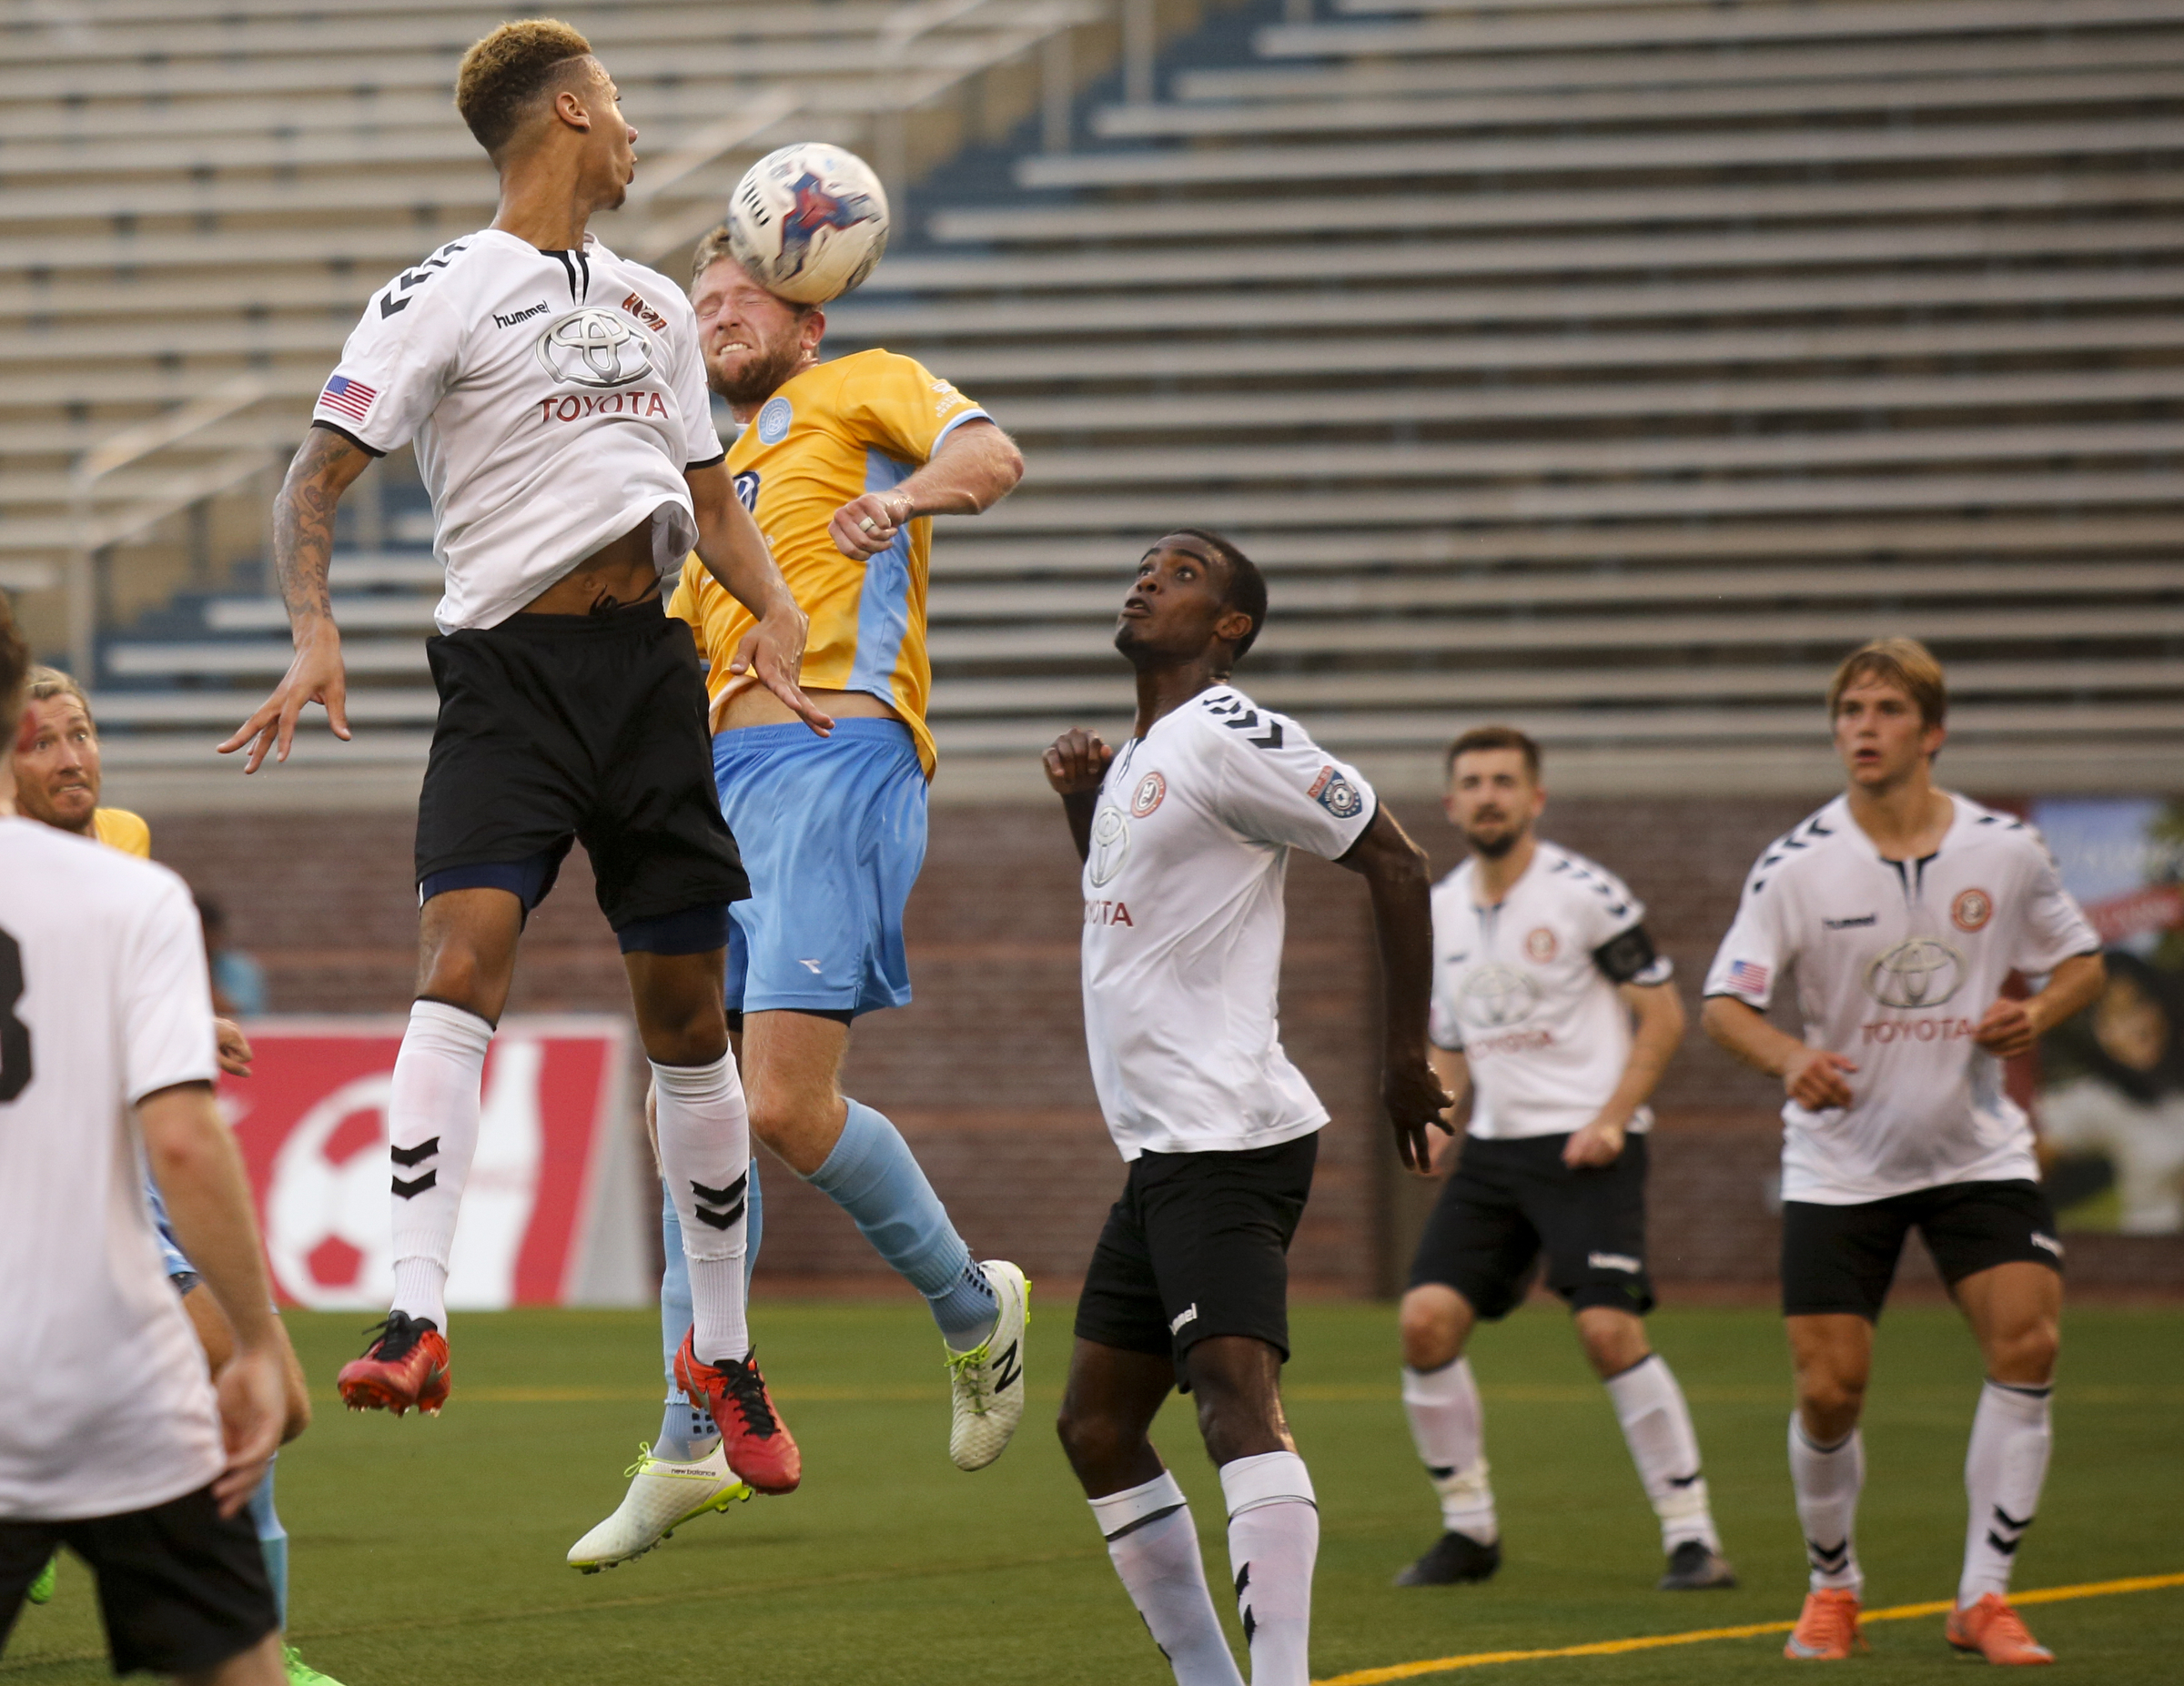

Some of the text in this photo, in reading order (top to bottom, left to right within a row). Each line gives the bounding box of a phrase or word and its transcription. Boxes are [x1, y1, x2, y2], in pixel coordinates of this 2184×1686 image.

[492, 299, 551, 329] hummel
[538, 391, 670, 422] TOYOTA
[1862, 1018, 1971, 1045] TOYOTA
